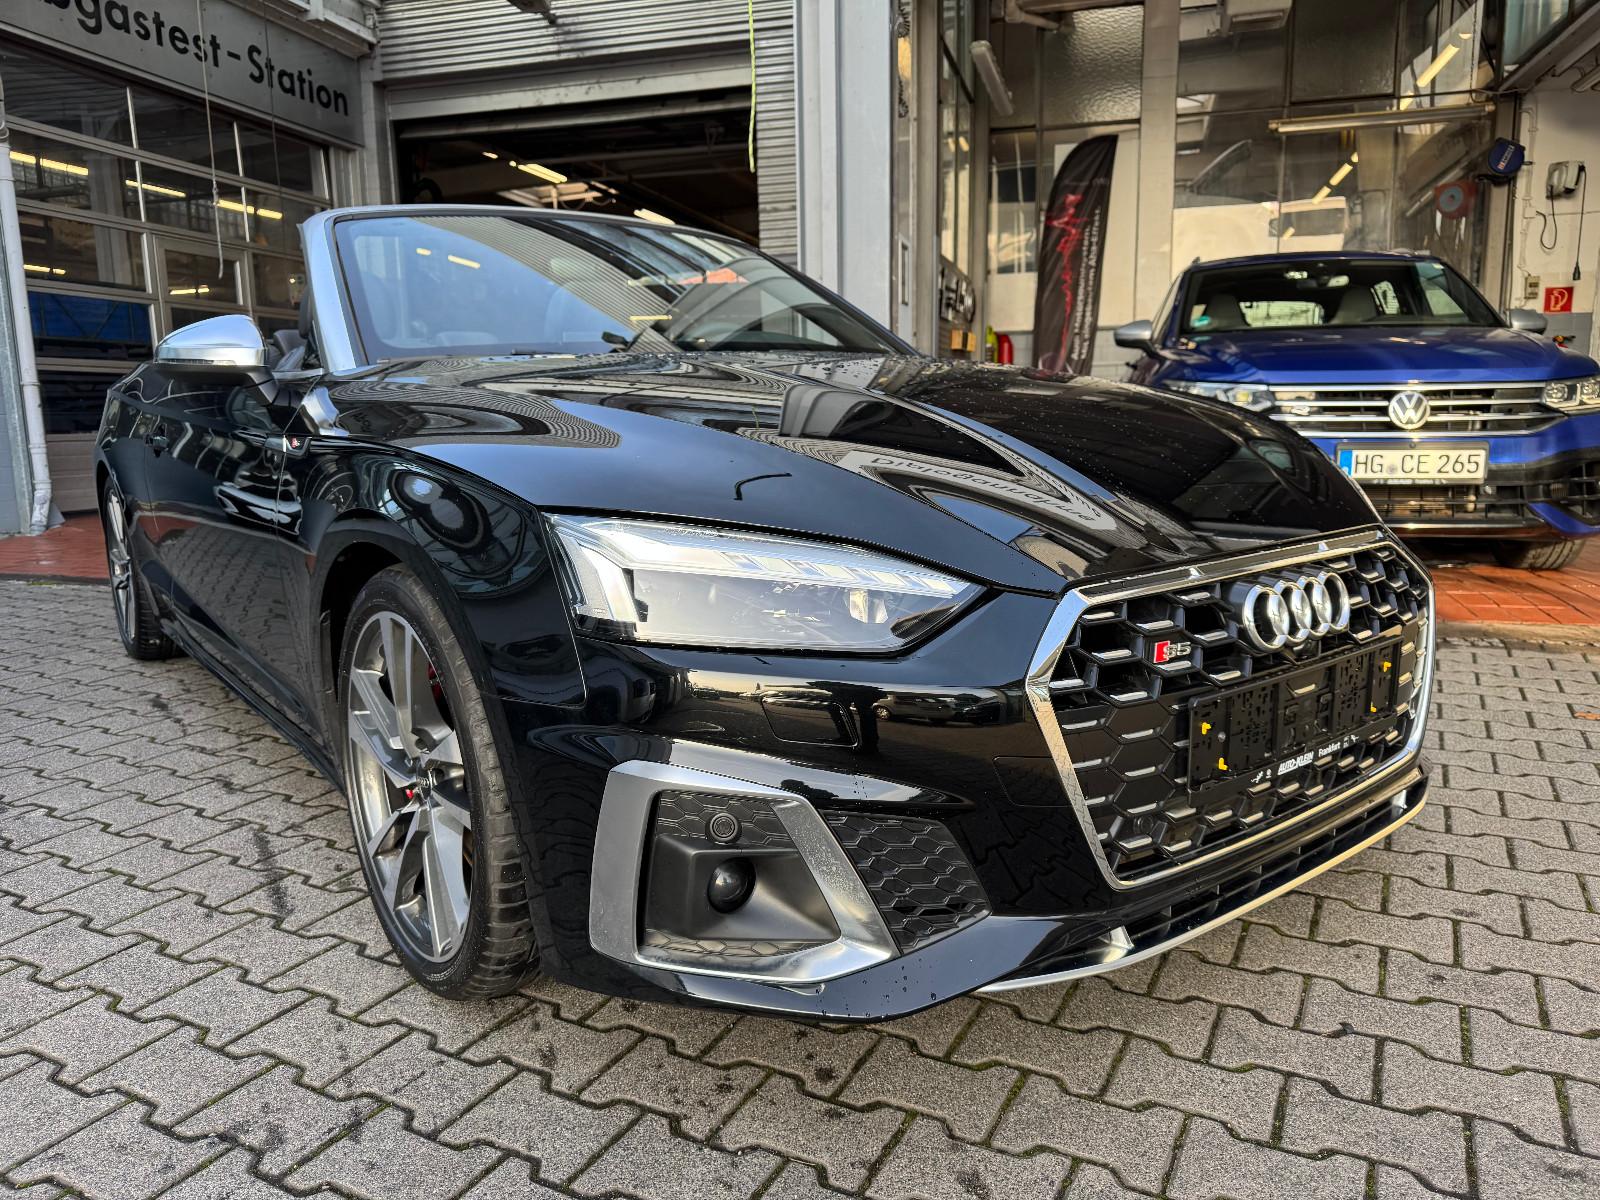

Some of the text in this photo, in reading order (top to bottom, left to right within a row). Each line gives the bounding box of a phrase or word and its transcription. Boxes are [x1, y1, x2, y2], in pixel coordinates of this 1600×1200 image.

[44, 0, 349, 117] gastest-Station
[1390, 392, 1429, 427] VW
[1354, 454, 1481, 474] HG CE 265
[1163, 641, 1191, 658] S5
[1278, 751, 1314, 775] AUTO-KLEIN
[1318, 742, 1341, 757] Frankfurt
